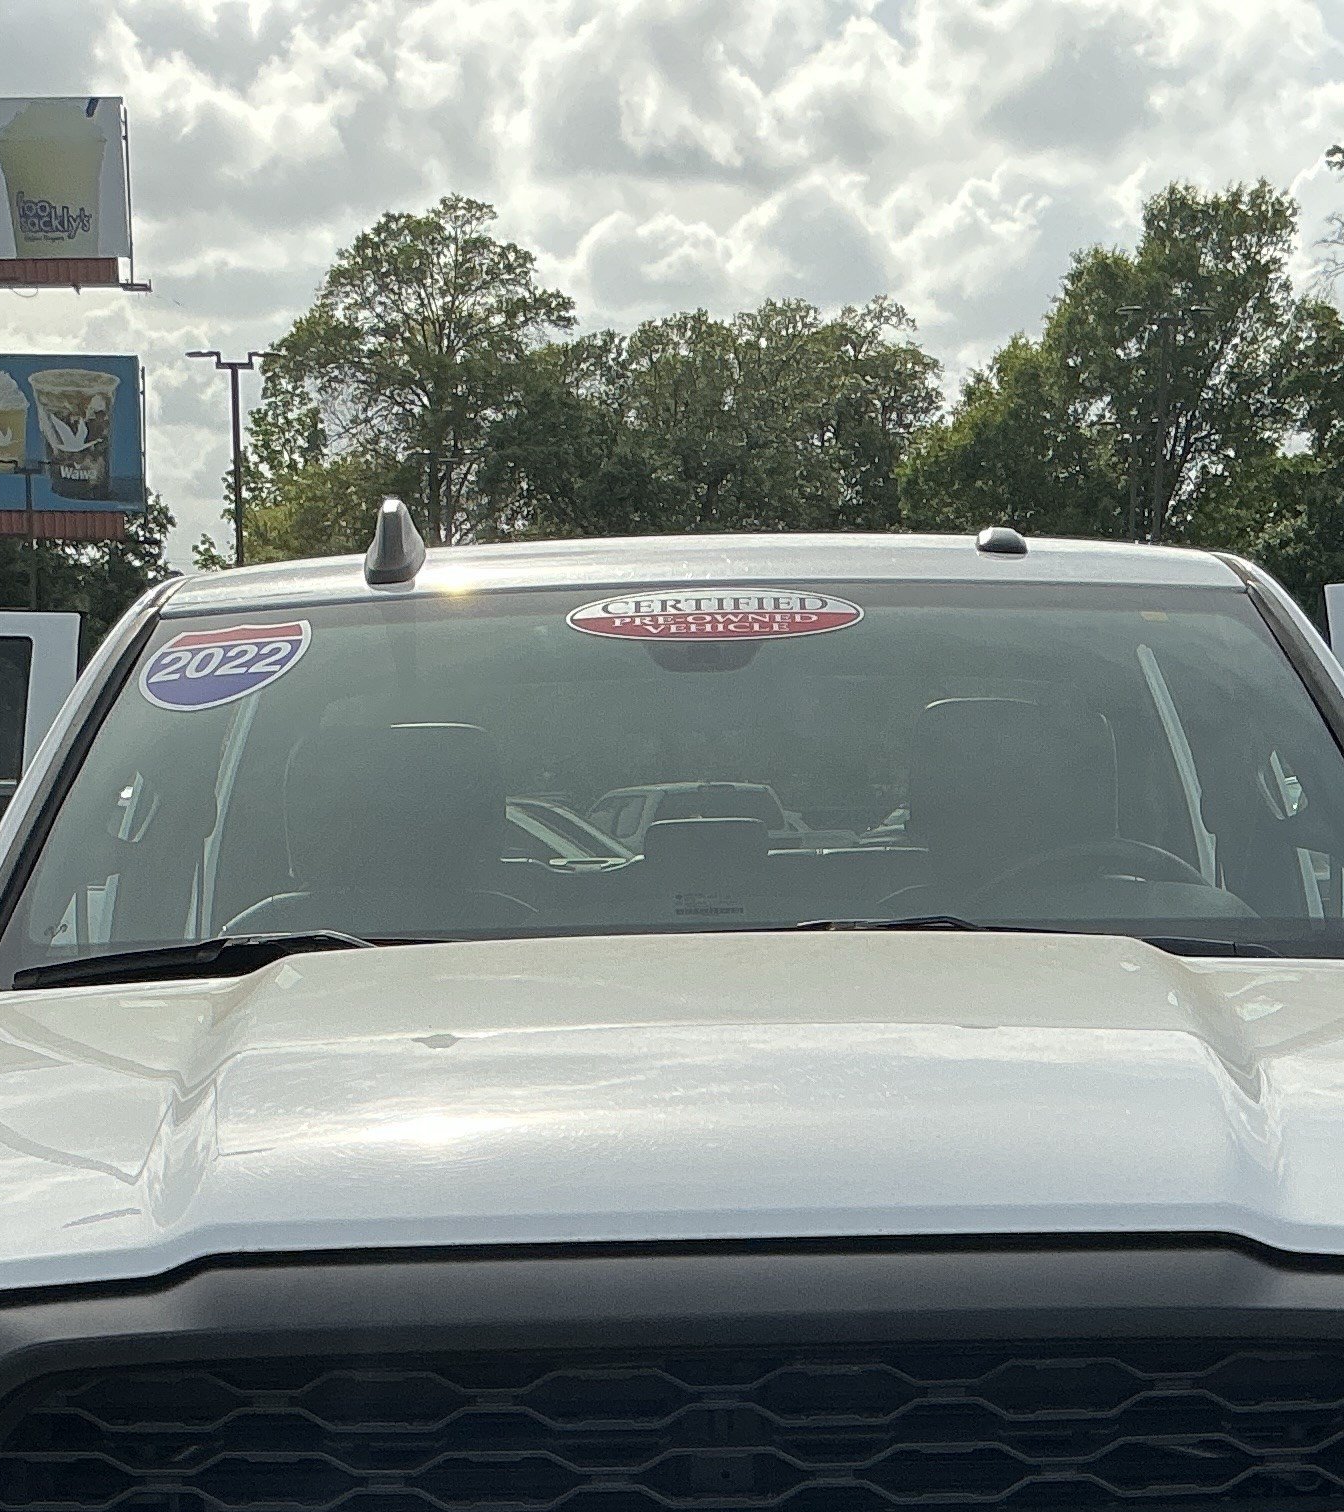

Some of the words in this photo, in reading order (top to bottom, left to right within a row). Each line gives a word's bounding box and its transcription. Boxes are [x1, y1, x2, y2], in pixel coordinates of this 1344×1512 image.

[600, 596, 830, 616] CERTIFIED
[612, 612, 820, 628] PRE-OWNED
[643, 621, 791, 635] VEHICLE
[147, 641, 293, 684] 2022
